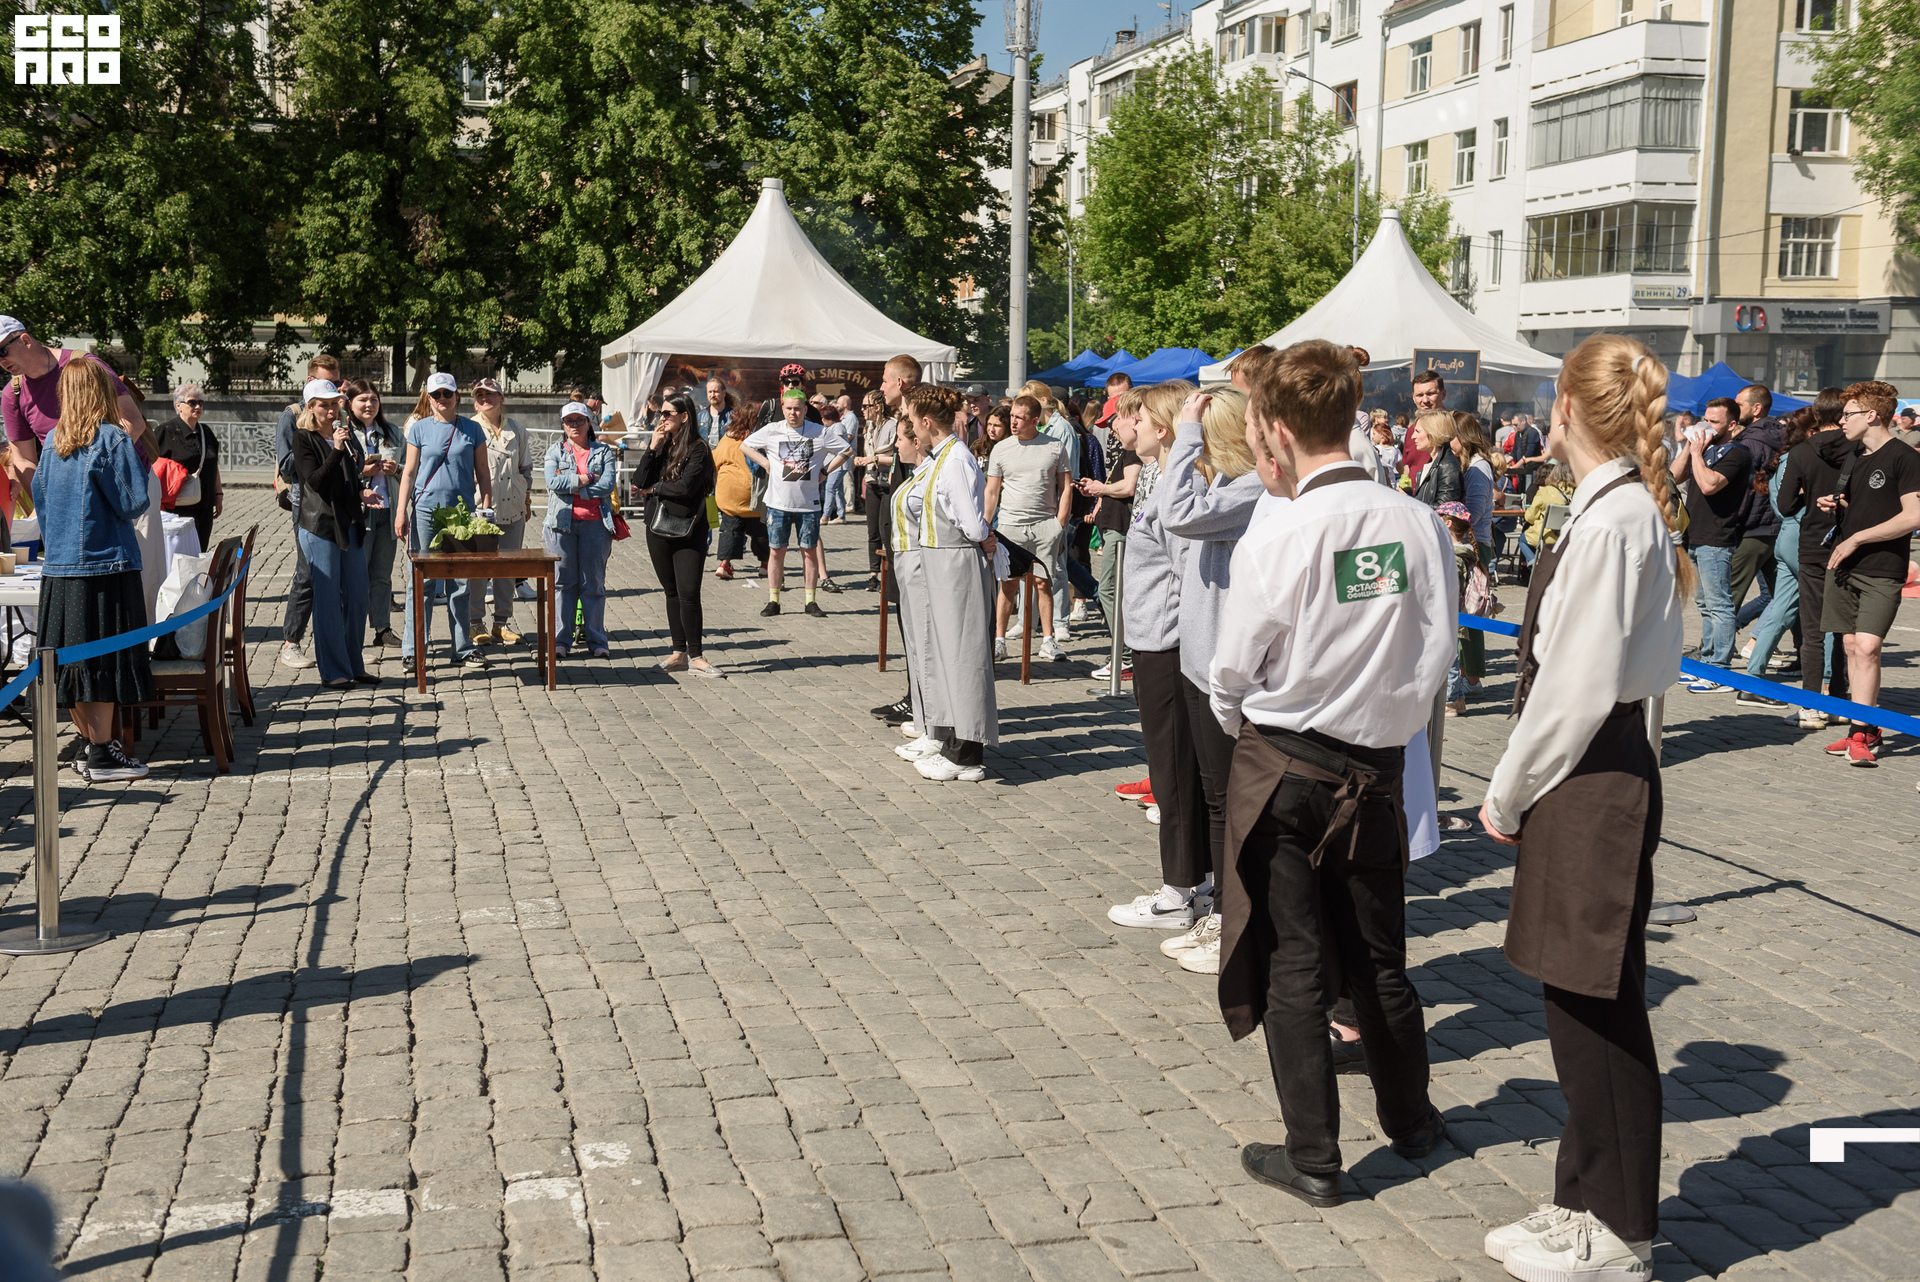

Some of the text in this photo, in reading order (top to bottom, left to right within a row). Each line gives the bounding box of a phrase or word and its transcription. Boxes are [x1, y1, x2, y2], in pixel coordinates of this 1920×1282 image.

[1676, 286, 1688, 298] 29
[1427, 357, 1465, 374] Lamadjo
[1355, 551, 1382, 580] 8
[1346, 578, 1398, 594] ЭСТАФЕТА
[1346, 585, 1400, 600] ОФИЦИАНТОВ
